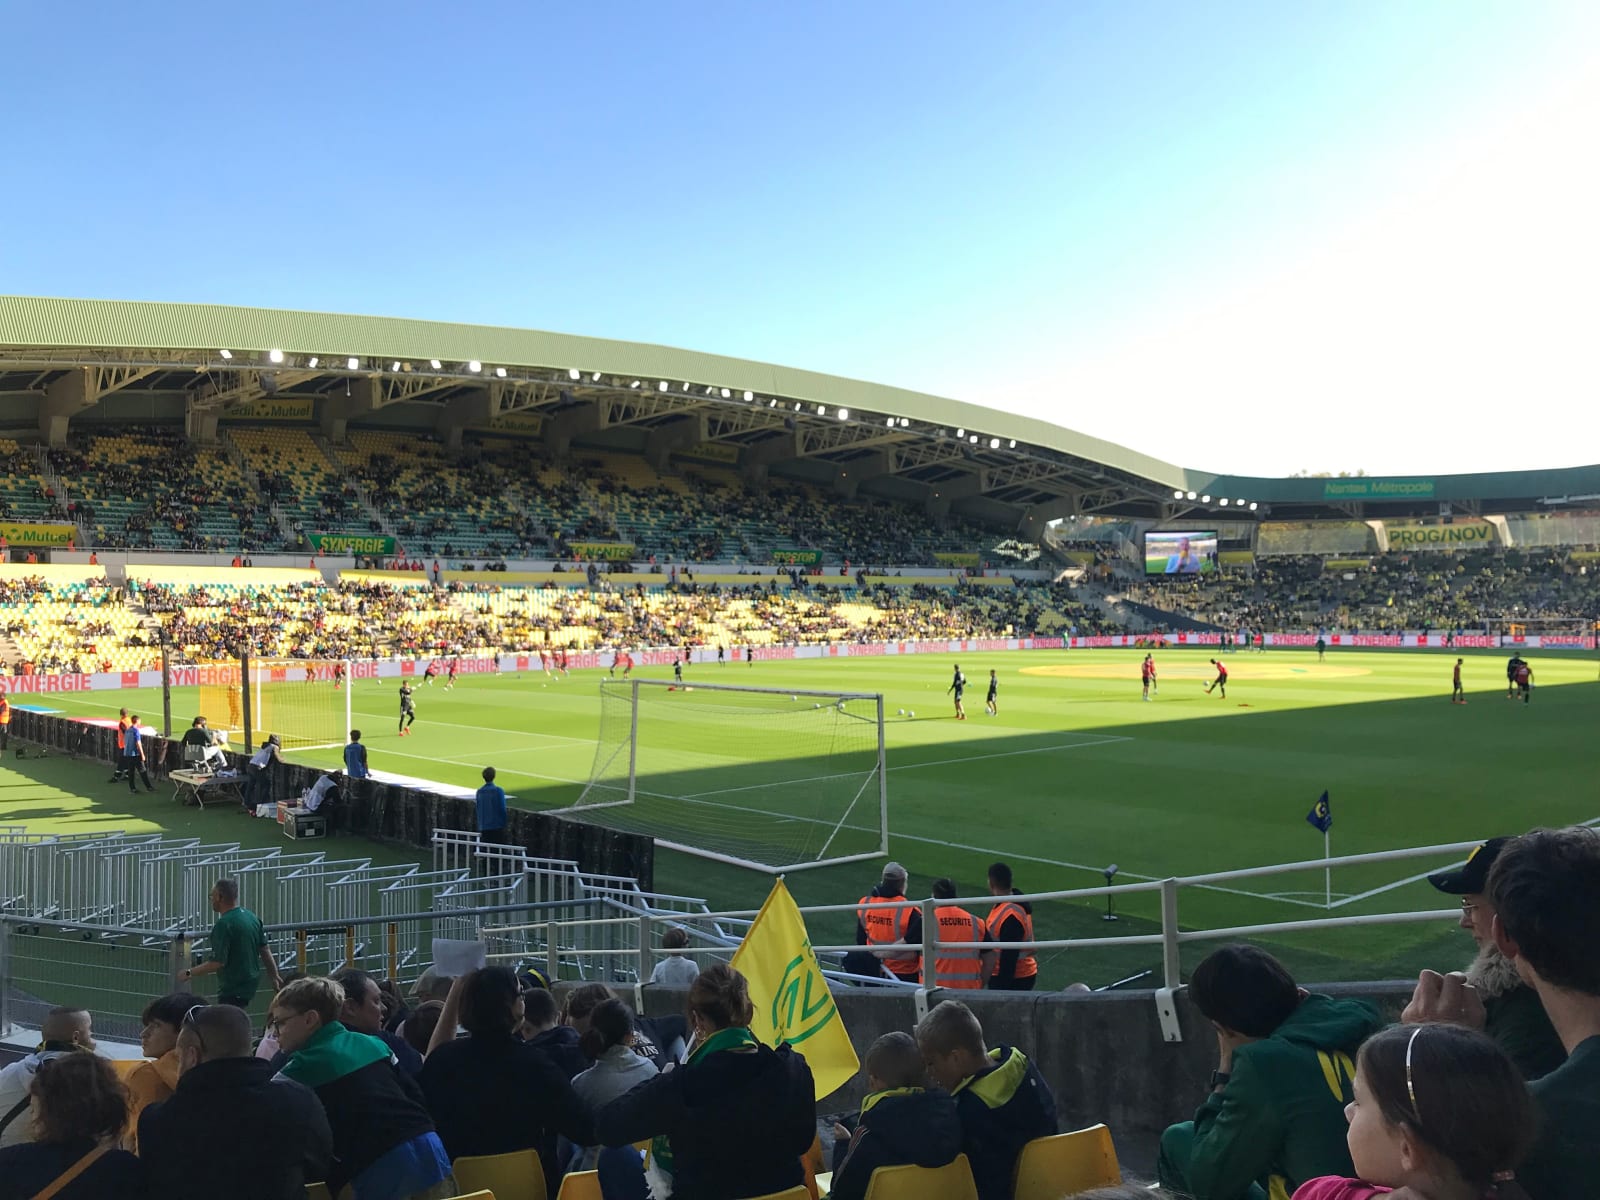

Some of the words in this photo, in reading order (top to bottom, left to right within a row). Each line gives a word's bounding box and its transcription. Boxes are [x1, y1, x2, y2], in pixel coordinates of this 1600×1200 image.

[271, 405, 311, 417] Mutuel
[23, 530, 71, 543] Mutuel
[320, 537, 386, 553] SYNERGIE
[940, 917, 972, 927] SECURITE
